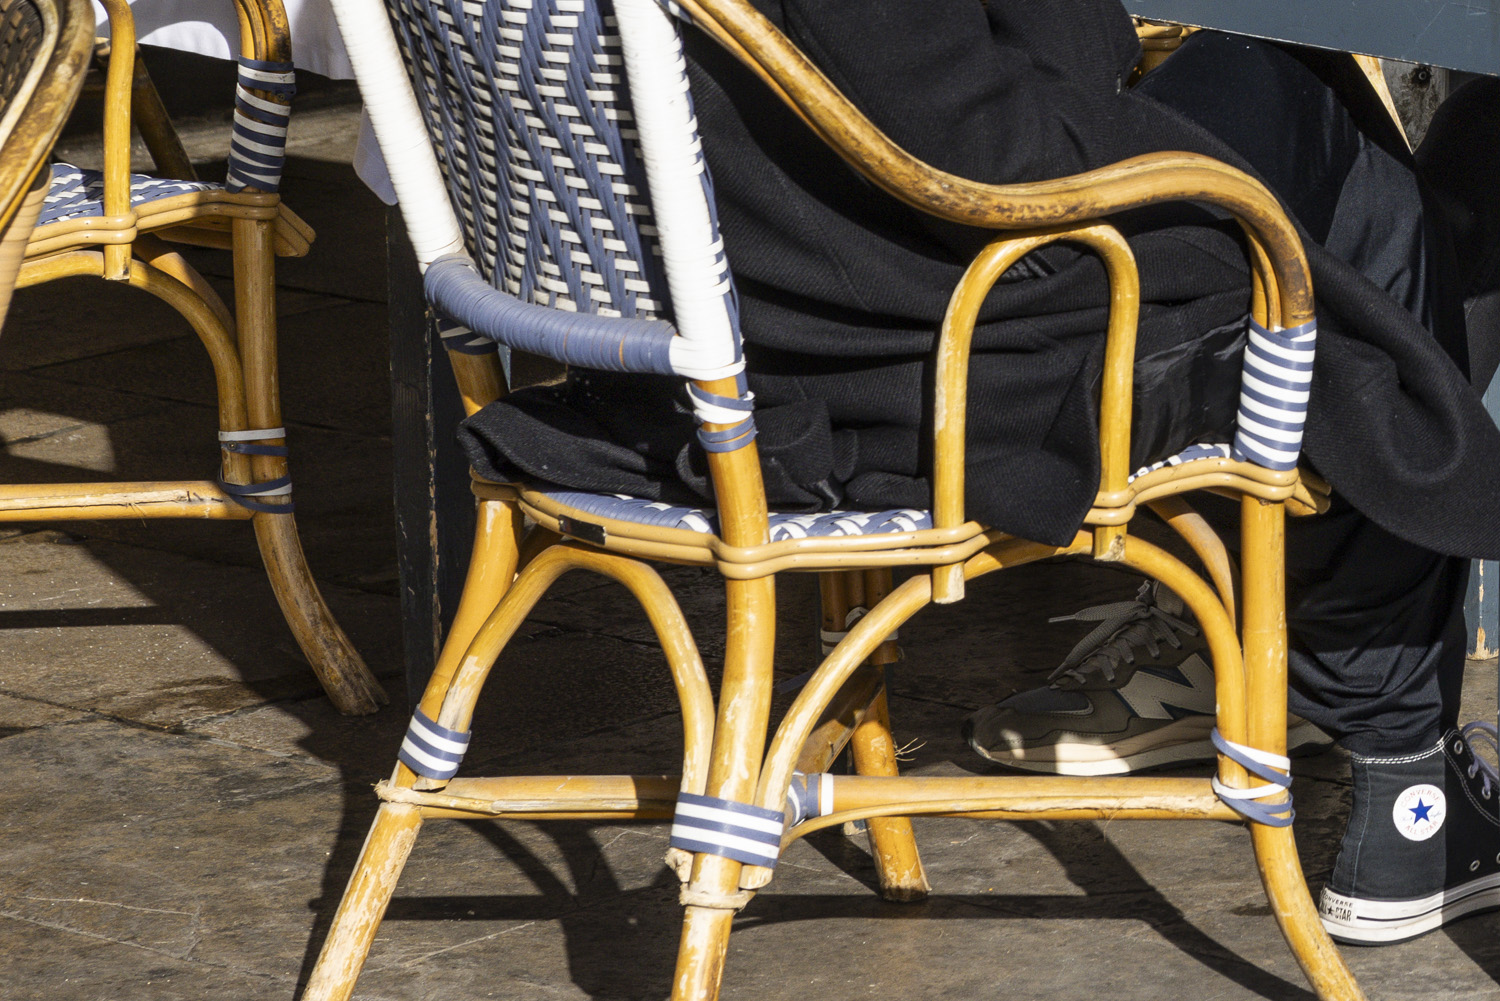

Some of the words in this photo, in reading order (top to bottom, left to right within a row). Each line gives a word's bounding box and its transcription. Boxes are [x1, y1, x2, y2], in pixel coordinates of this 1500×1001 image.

[1400, 788, 1441, 808] CONVERSE
[1405, 824, 1417, 835] ALL
[1420, 820, 1439, 835] STAR
[1335, 906, 1353, 922] STAR
